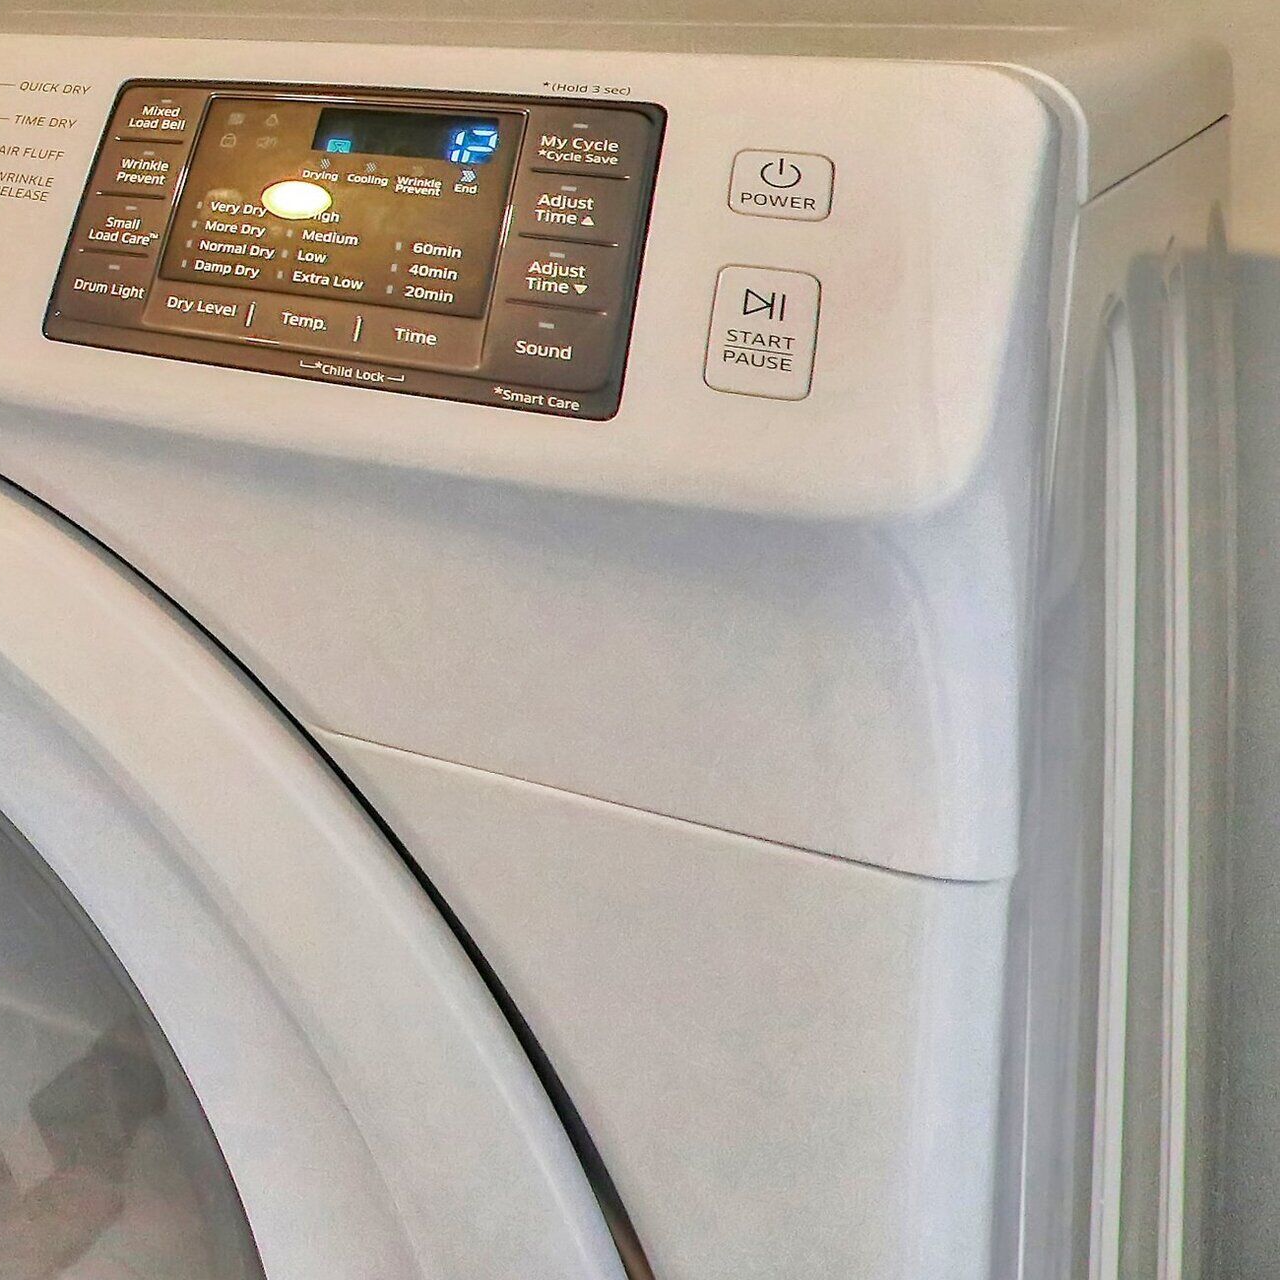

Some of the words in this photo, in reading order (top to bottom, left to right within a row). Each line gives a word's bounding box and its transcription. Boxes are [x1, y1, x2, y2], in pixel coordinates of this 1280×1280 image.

[19, 81, 60, 93] QUICK
[62, 84, 92, 95] DRY
[592, 85, 600, 93] 3
[604, 87, 631, 96] sec)
[142, 105, 180, 118] Mixed
[15, 114, 46, 127] TIME
[48, 117, 78, 129] DRY
[128, 118, 159, 129] Load
[161, 119, 185, 131] Bell
[540, 135, 568, 149] My
[572, 137, 619, 153] Cycle
[23, 147, 65, 161] FLUFF
[585, 153, 619, 165] Save
[122, 158, 169, 172] Wrinkle
[116, 171, 166, 186] Prevent
[302, 170, 339, 182] Drying
[347, 172, 389, 187] Cooling
[396, 176, 442, 189] Wrinkle
[395, 185, 440, 197] Prevent
[454, 183, 478, 194] End
[211, 201, 240, 214] Very
[242, 204, 268, 218] Dry
[537, 194, 594, 210] Adjust
[740, 192, 816, 211] POWER
[105, 216, 141, 230] Small
[535, 209, 578, 225] Time
[88, 228, 119, 242] Load
[205, 220, 238, 233] More
[240, 224, 266, 238] Dry
[302, 229, 359, 246] Medium
[199, 239, 246, 255] Normal
[249, 245, 276, 260] Dry
[297, 250, 328, 264] Low
[412, 242, 463, 259] 60min
[194, 259, 232, 276] Damp
[234, 264, 260, 279] Dry
[408, 264, 459, 281] 40min
[528, 261, 586, 279] Adjust
[292, 270, 330, 286] Extra
[333, 275, 364, 290] Low
[526, 277, 570, 294] Time
[73, 278, 108, 294] Drum
[110, 283, 145, 300] Light
[404, 285, 454, 303] 20min
[166, 296, 194, 313] Dry
[197, 300, 238, 317] Level
[281, 311, 328, 331] Temp.
[394, 327, 438, 346] Time
[726, 329, 796, 350] START
[515, 340, 573, 360] Sound
[723, 350, 792, 372] PAUSE
[356, 368, 385, 383] Lock
[547, 396, 580, 411] Care
